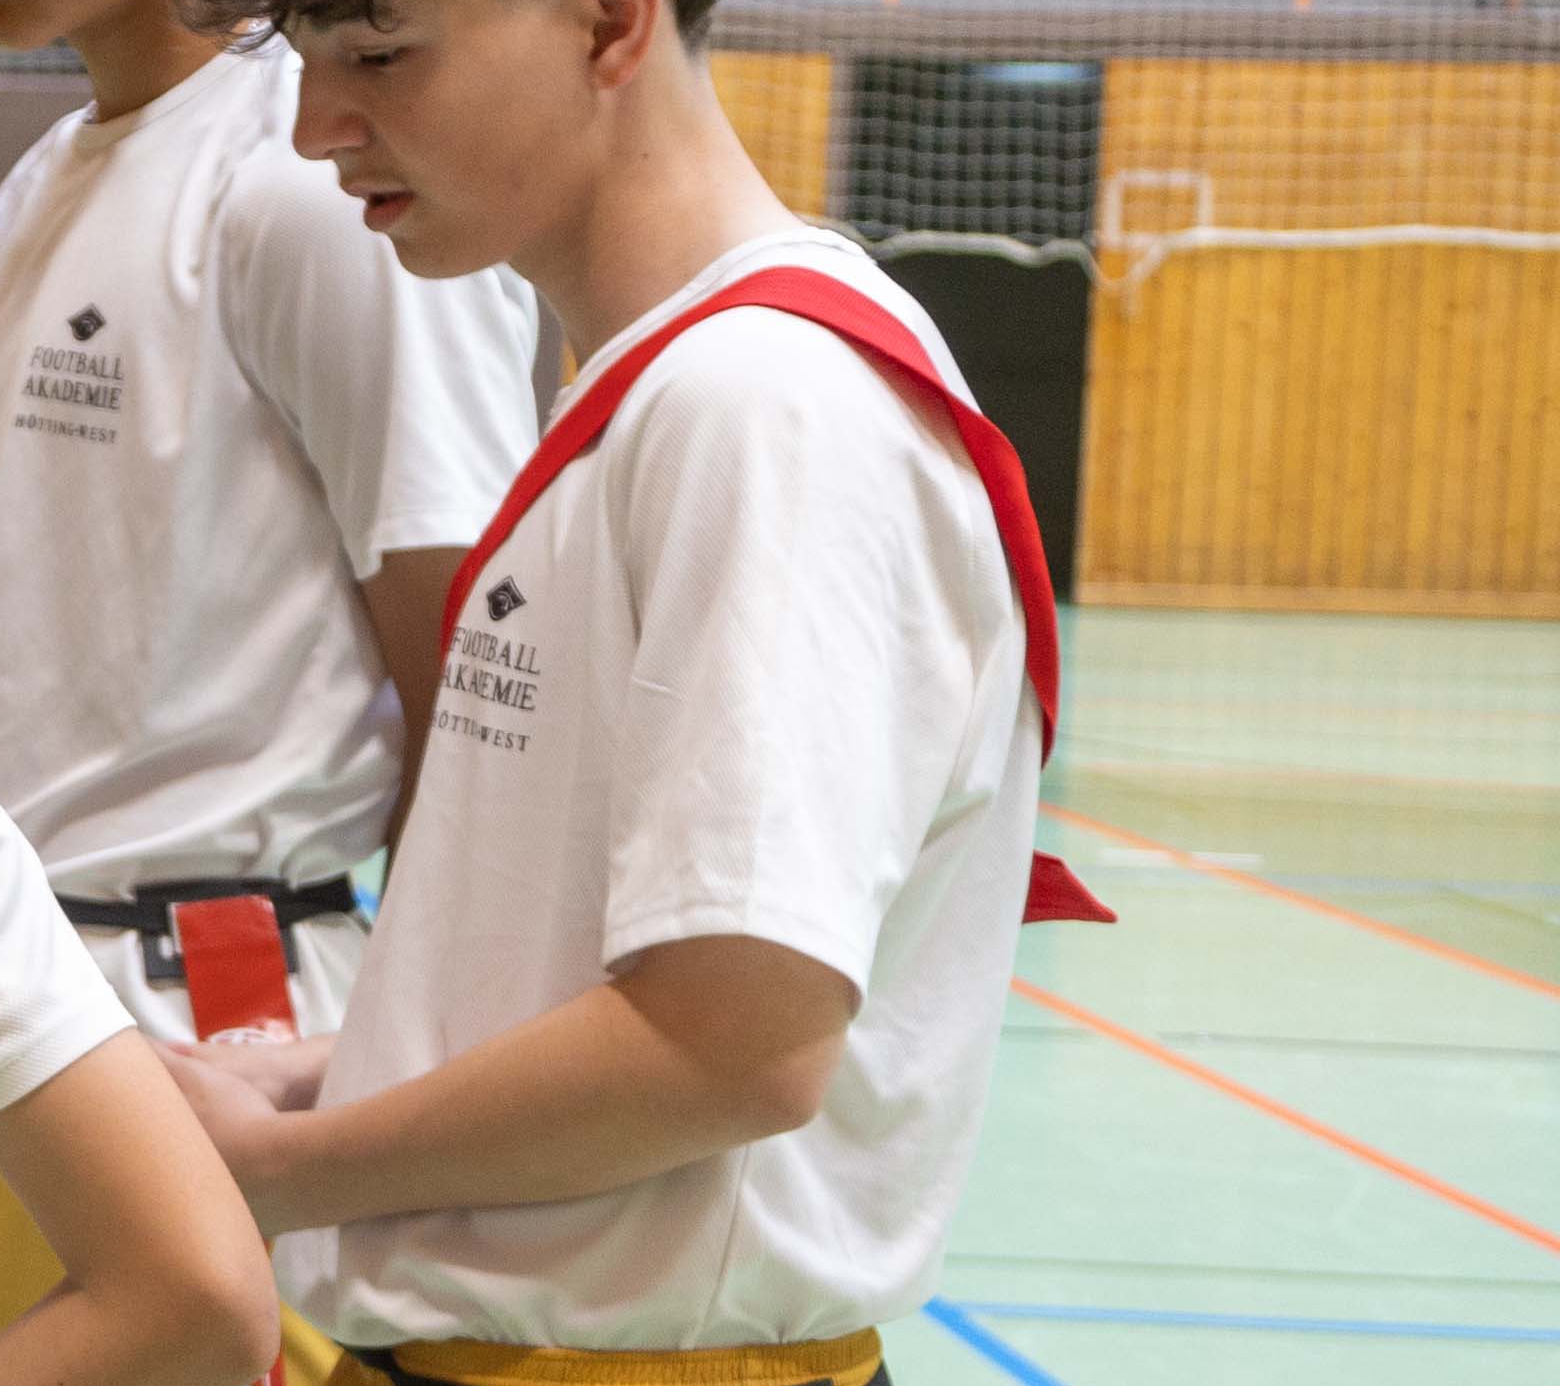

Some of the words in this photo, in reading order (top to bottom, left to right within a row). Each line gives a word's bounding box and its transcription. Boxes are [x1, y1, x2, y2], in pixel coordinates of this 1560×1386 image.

[30, 346, 123, 380] FOOTBALL
[22, 375, 123, 410] AKADEMIE
[450, 626, 540, 676] FOOTBALL
